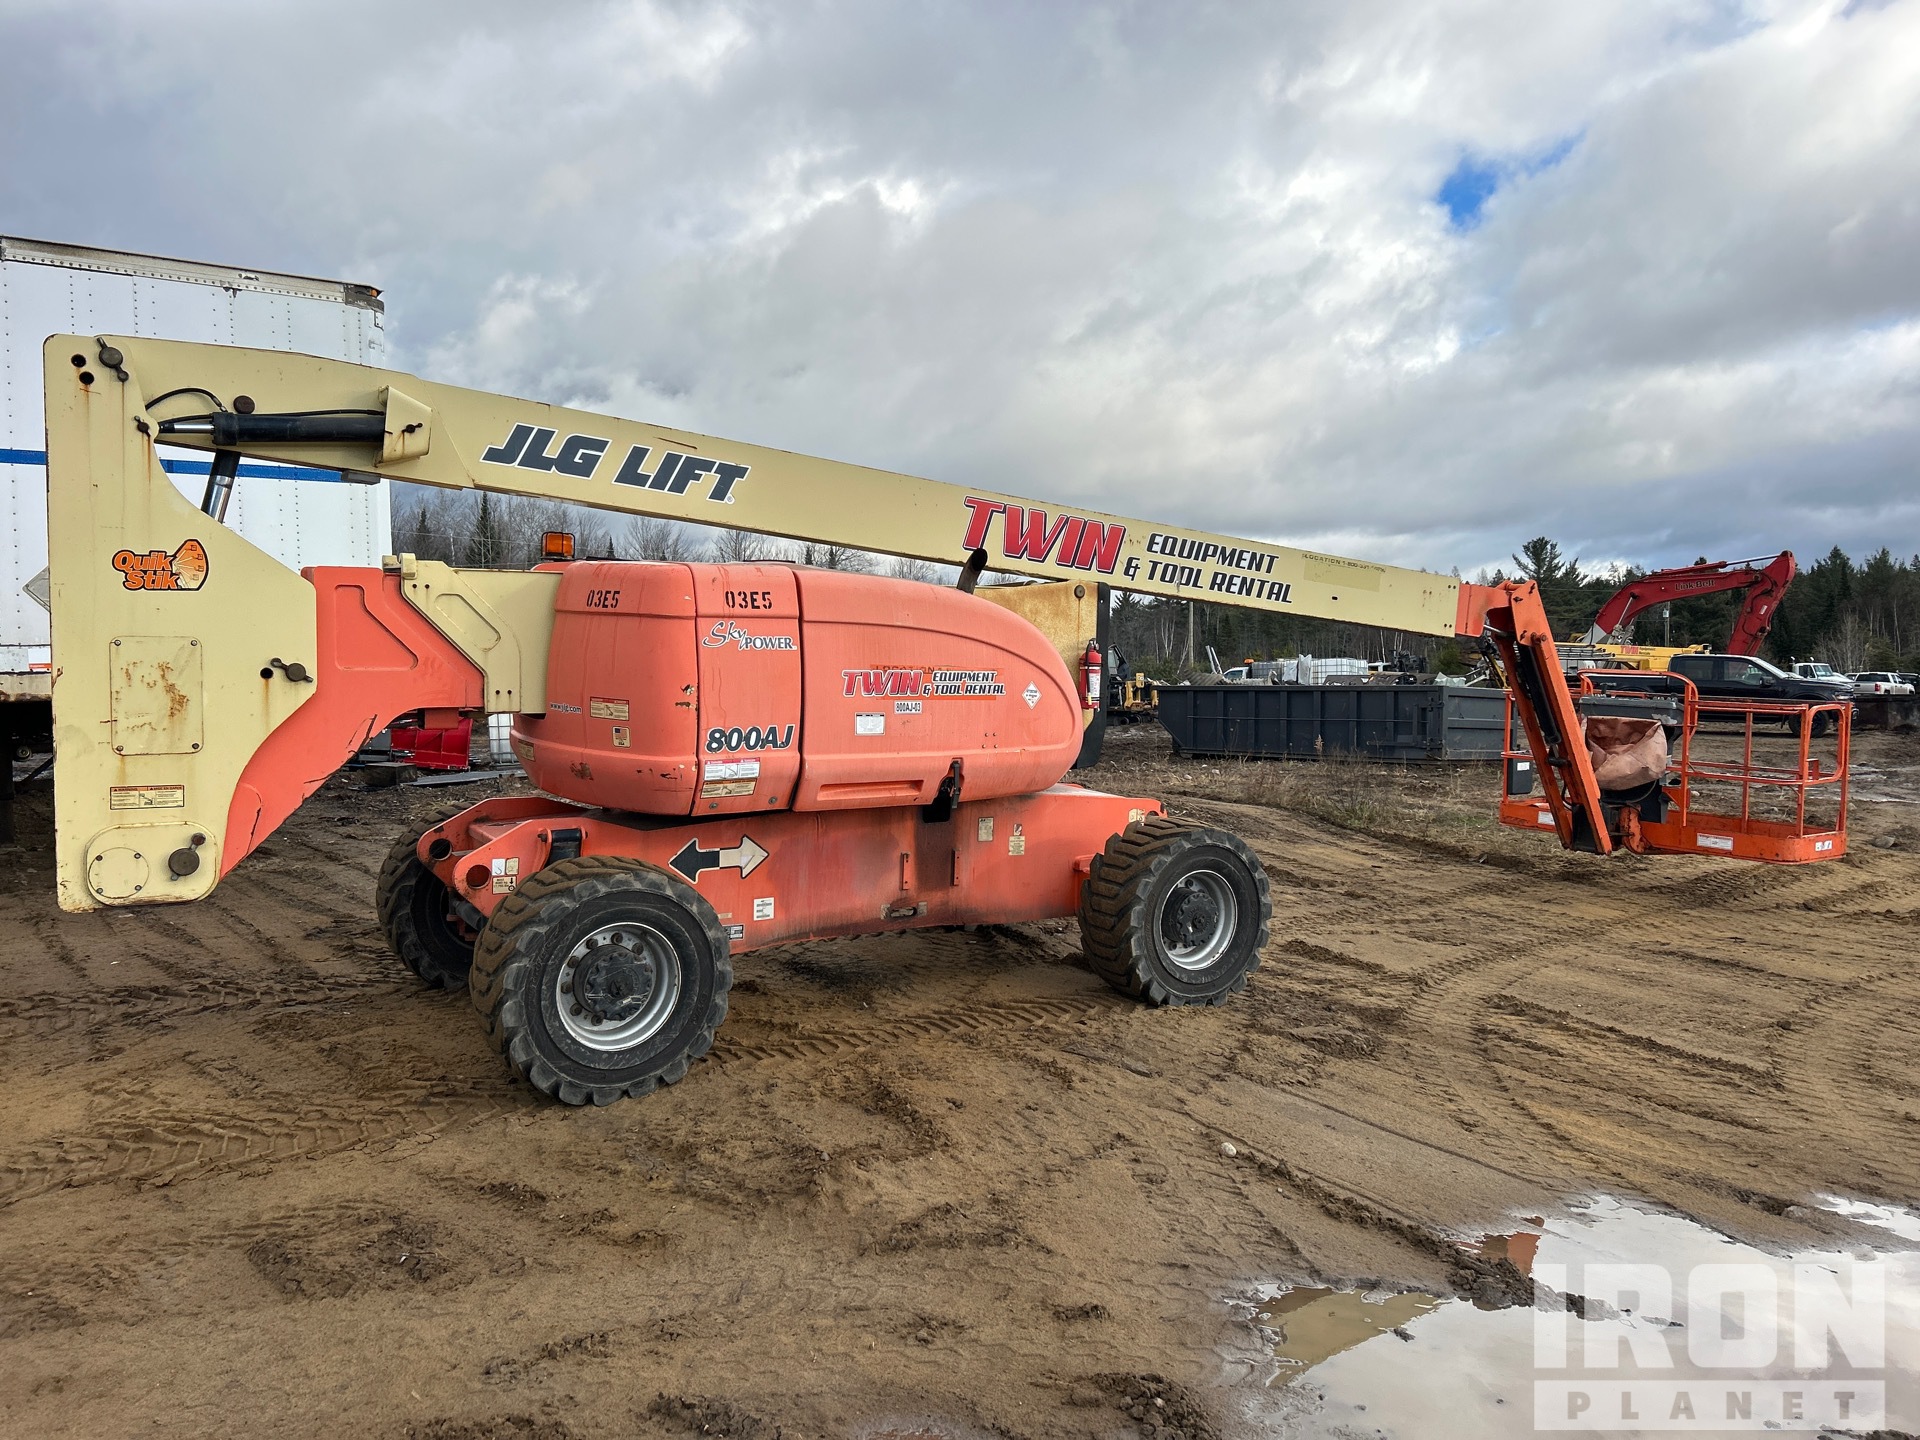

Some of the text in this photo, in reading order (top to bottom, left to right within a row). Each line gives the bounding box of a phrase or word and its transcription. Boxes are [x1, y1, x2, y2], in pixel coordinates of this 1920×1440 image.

[480, 424, 750, 502] JLG LIFT
[963, 496, 1126, 574] TWIN
[114, 551, 173, 573] Quik
[1147, 533, 1279, 574] EQUIPMENT
[124, 571, 179, 590] Stik
[1123, 557, 1293, 603] & TOOL RENTAL
[1675, 580, 1715, 591] Link-Belt
[586, 589, 621, 609] 03E5
[725, 591, 773, 610] 03E5
[843, 670, 923, 697] TWIN
[932, 671, 997, 683] EQUIPMENT
[923, 684, 1006, 696] & TOOL RENTAL
[550, 703, 582, 713] www.jlg.com
[895, 702, 921, 712] 800AJ-03
[705, 725, 795, 753] 800AJ
